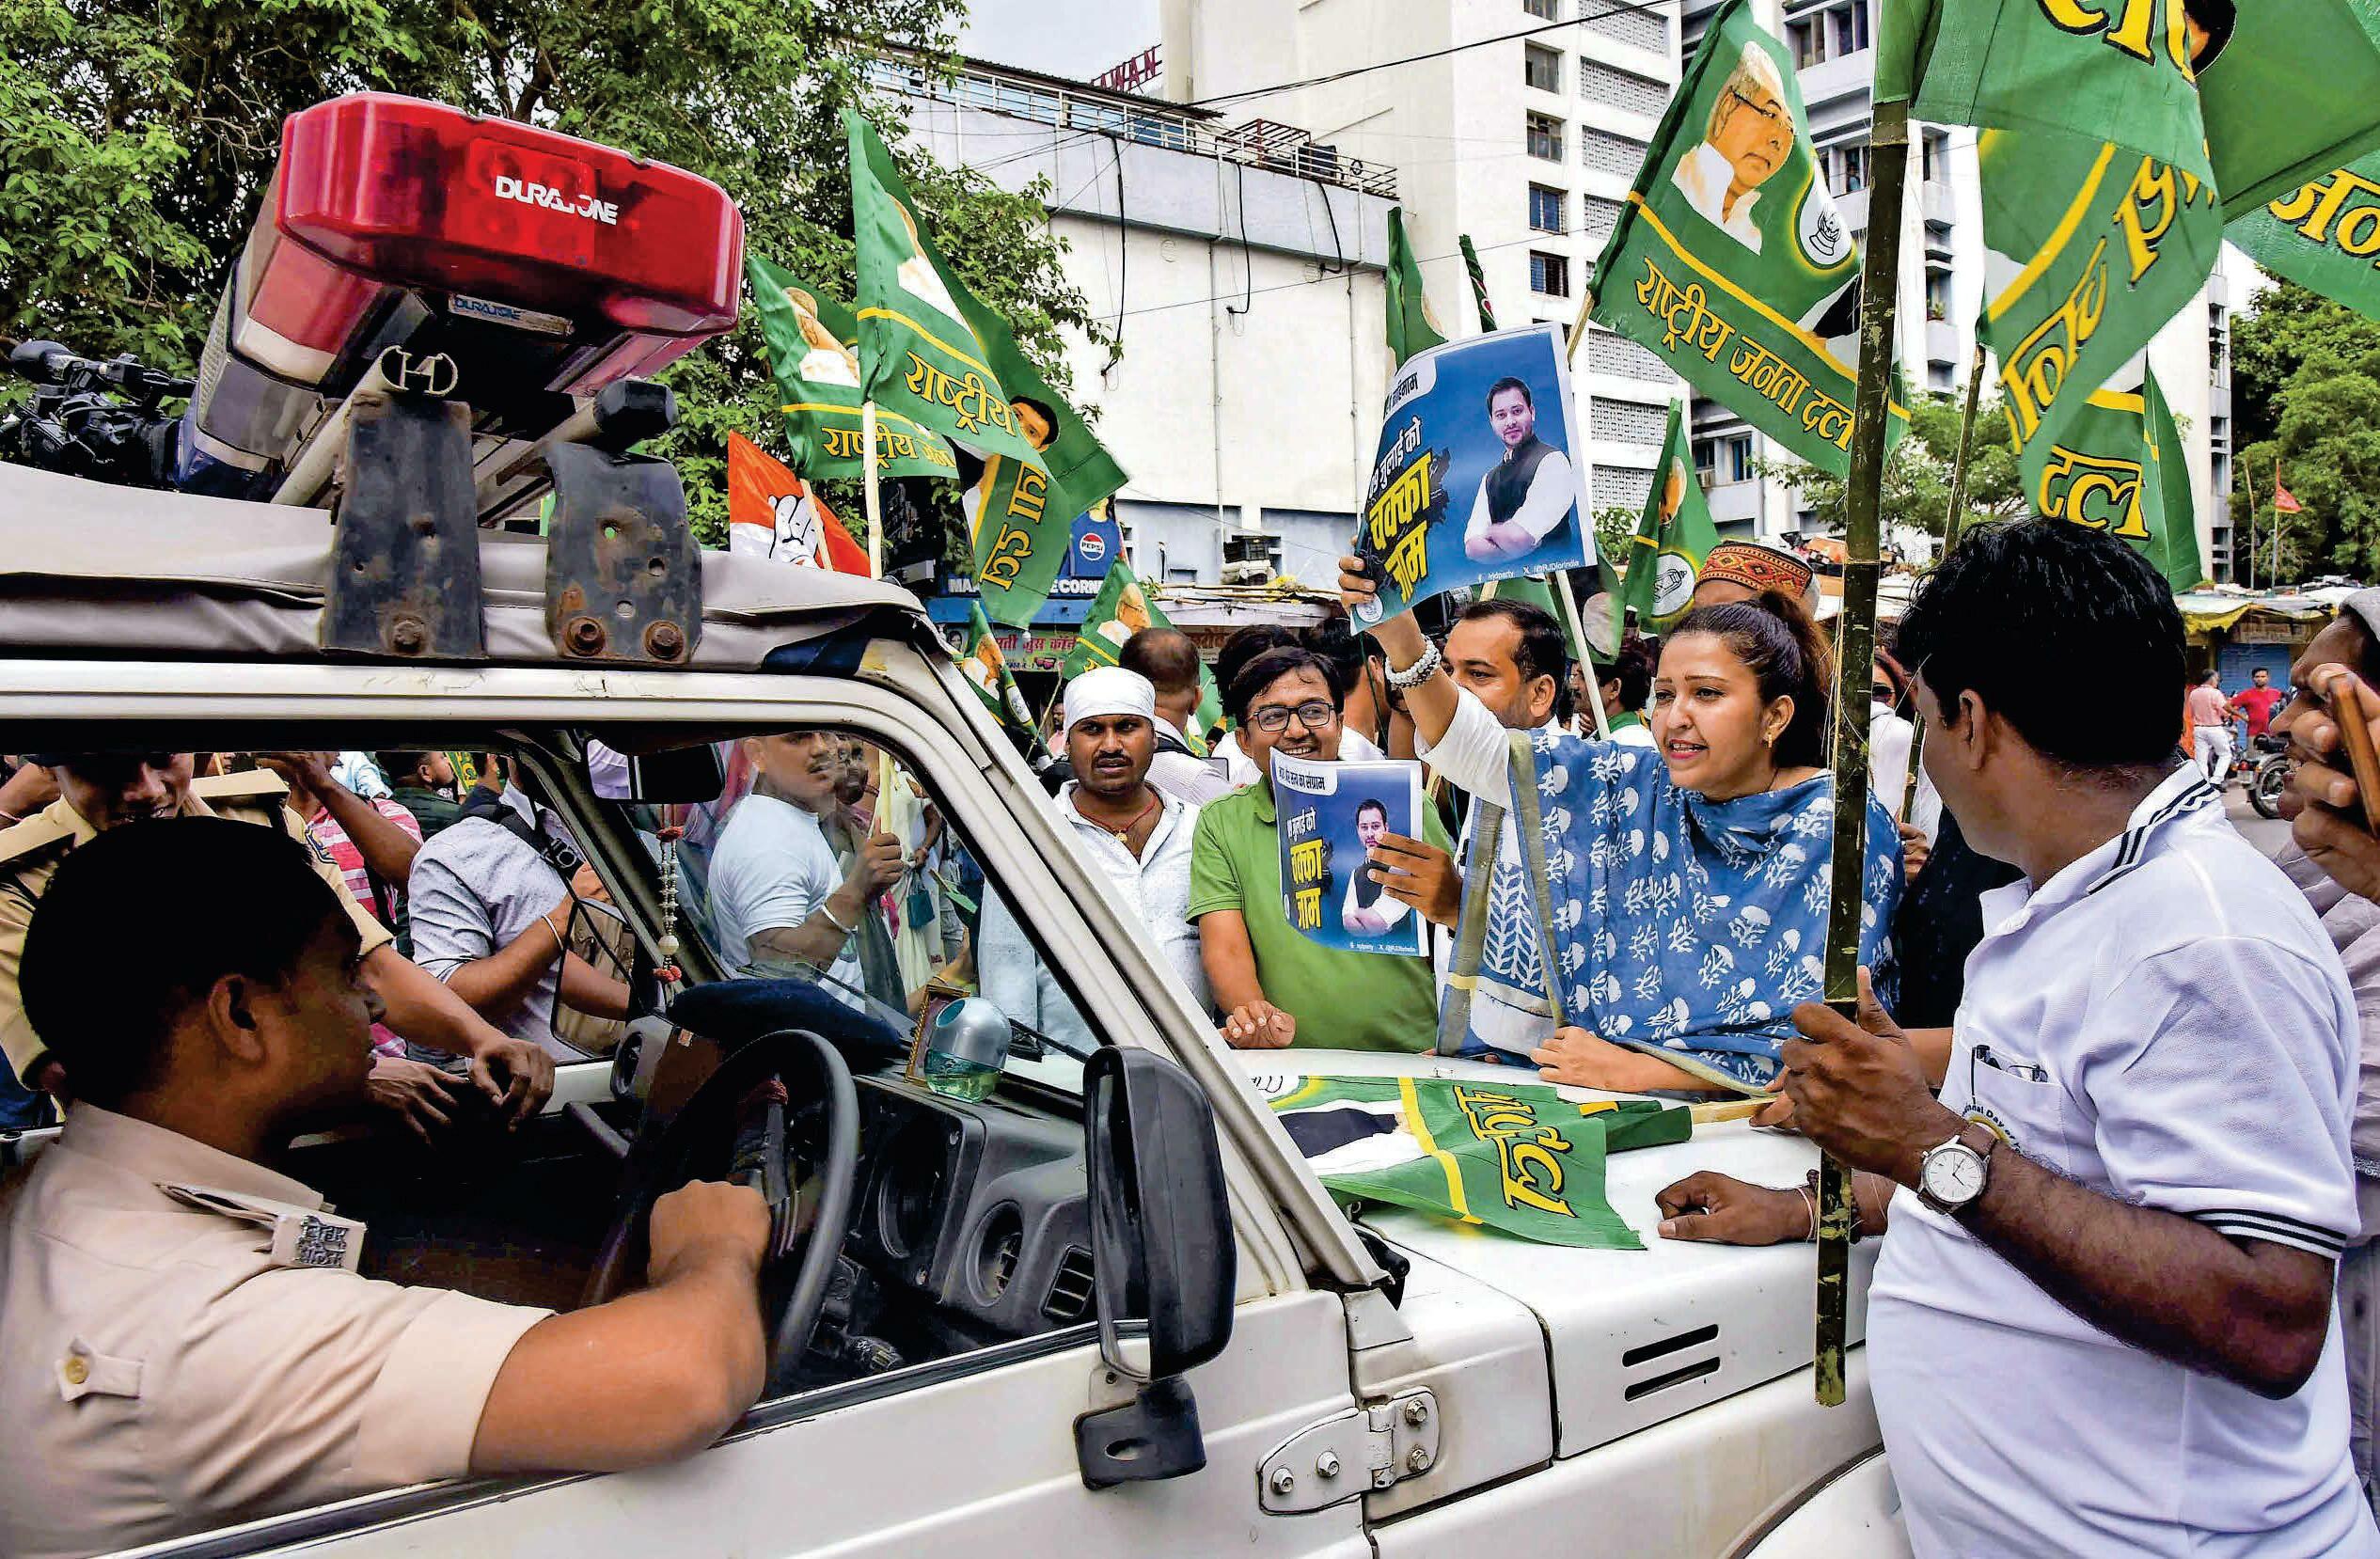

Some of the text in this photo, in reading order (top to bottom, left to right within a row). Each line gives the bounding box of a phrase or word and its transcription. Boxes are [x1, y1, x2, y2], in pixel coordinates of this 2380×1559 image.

[1635, 257, 1856, 453] राष्ट्रीय जनता दल
[903, 350, 1017, 437] राष्ट्रीय
[1405, 415, 1422, 453] को
[2038, 443, 2151, 542] दल
[947, 578, 981, 594] MA
[1985, 1109, 2005, 1128] Day
